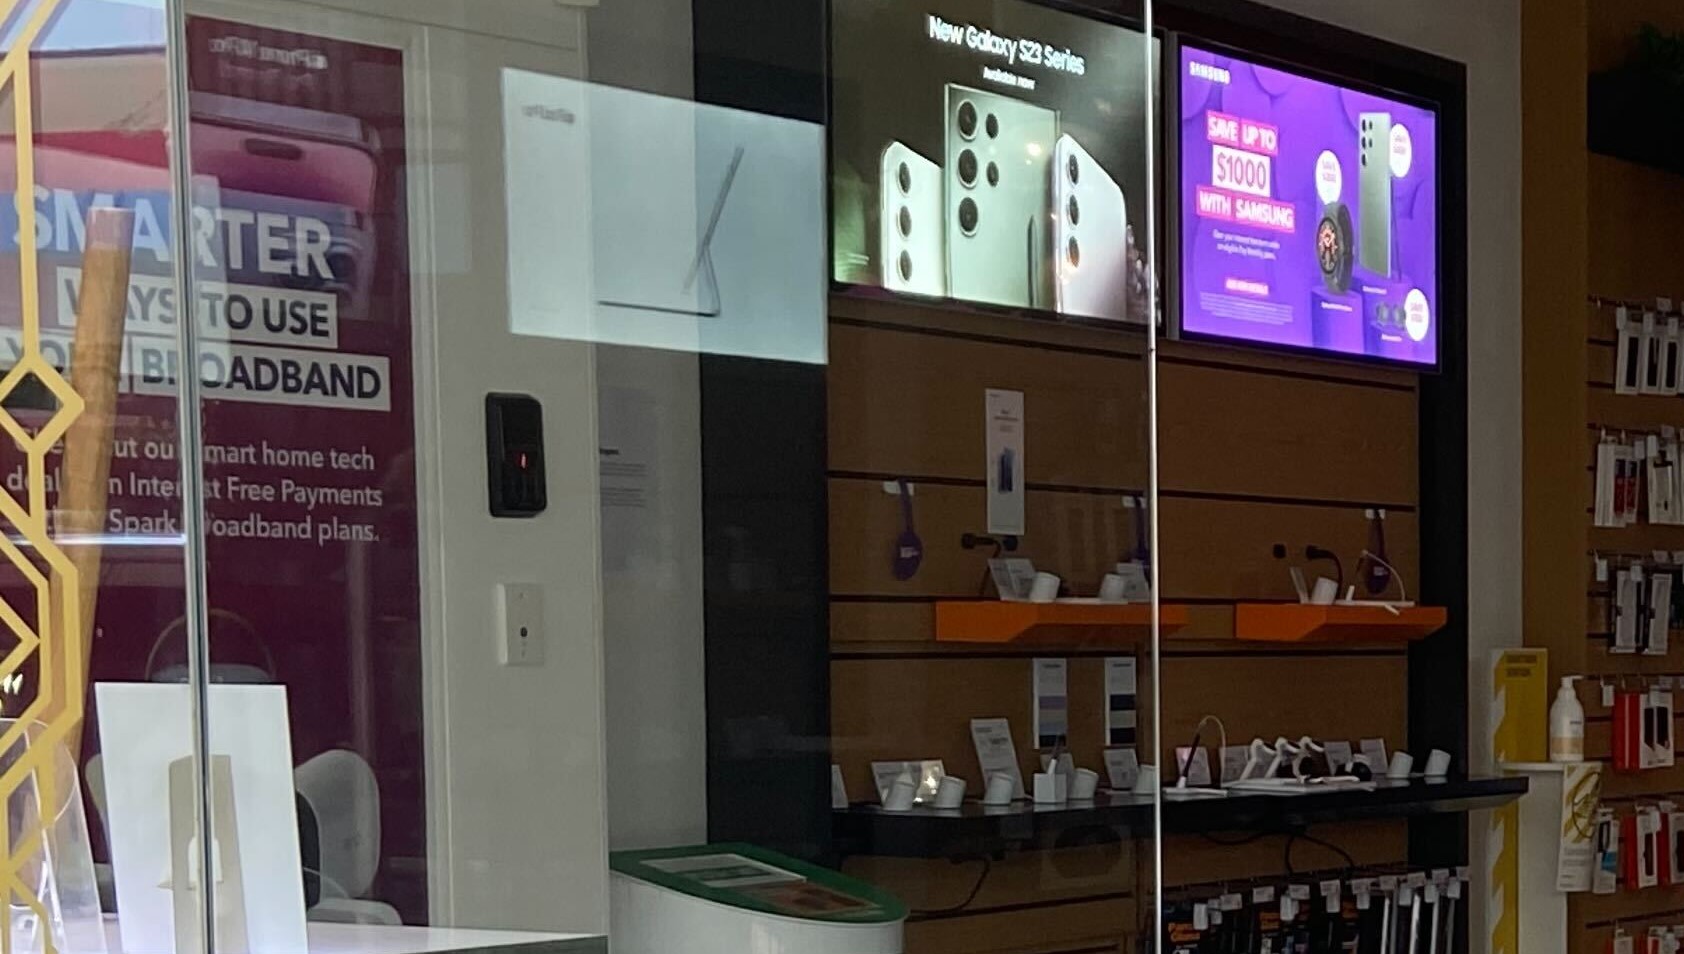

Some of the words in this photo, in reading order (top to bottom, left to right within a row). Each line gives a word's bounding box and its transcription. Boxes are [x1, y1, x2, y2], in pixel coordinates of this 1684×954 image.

[929, 16, 965, 46] New
[966, 26, 1017, 64] Galaxy
[1019, 40, 1043, 65] S23
[1044, 47, 1085, 75] Series
[1190, 62, 1230, 84] SAMSUNG
[1208, 116, 1239, 143] SAVE
[1241, 121, 1258, 146] UP
[1258, 126, 1277, 150] TO
[1217, 152, 1267, 190] $1000
[1199, 191, 1232, 218] WITH
[1235, 197, 1294, 228] SAMSUNG
[206, 290, 254, 330] TO
[262, 295, 330, 338] USE
[203, 443, 257, 466] mart
[261, 445, 325, 468] home
[329, 446, 376, 470] tech
[129, 479, 222, 501] Intest
[227, 480, 276, 502] Free
[282, 482, 384, 511] Payments
[109, 509, 177, 535] Spark
[206, 510, 313, 539] oadband
[318, 518, 379, 545] plans.
